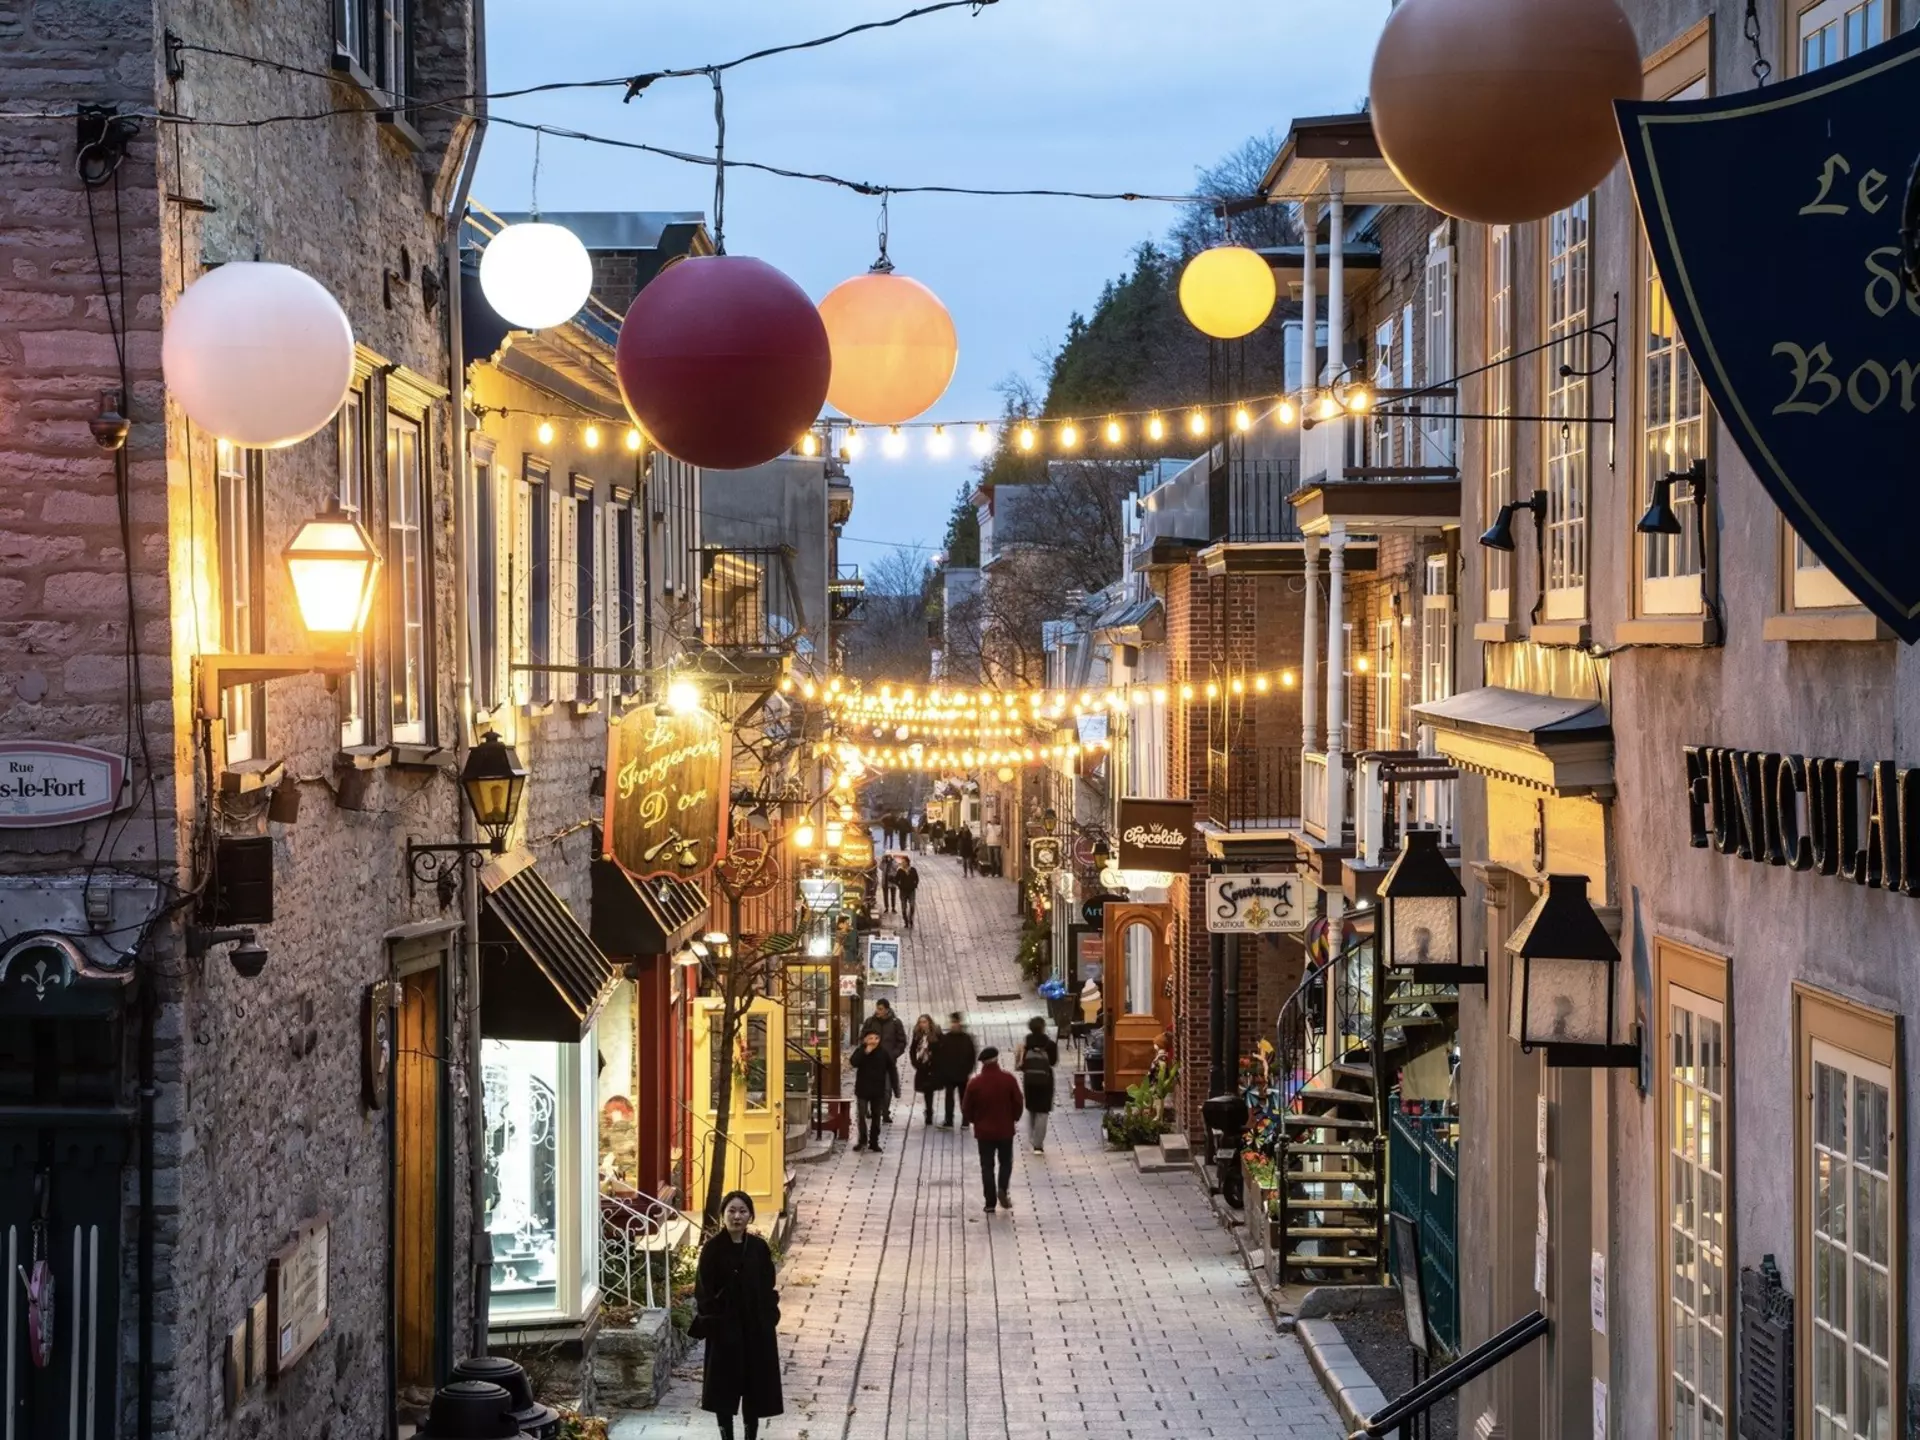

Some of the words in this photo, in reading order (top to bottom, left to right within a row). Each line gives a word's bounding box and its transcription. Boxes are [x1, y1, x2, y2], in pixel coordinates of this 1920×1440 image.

[1799, 153, 1888, 214] Le
[1864, 246, 1920, 318] d
[9, 761, 34, 773] Rue
[1123, 825, 1187, 849] Chocolato
[1212, 920, 1246, 929] BOUTIQUE
[1267, 920, 1301, 928] SOUVENIRS
